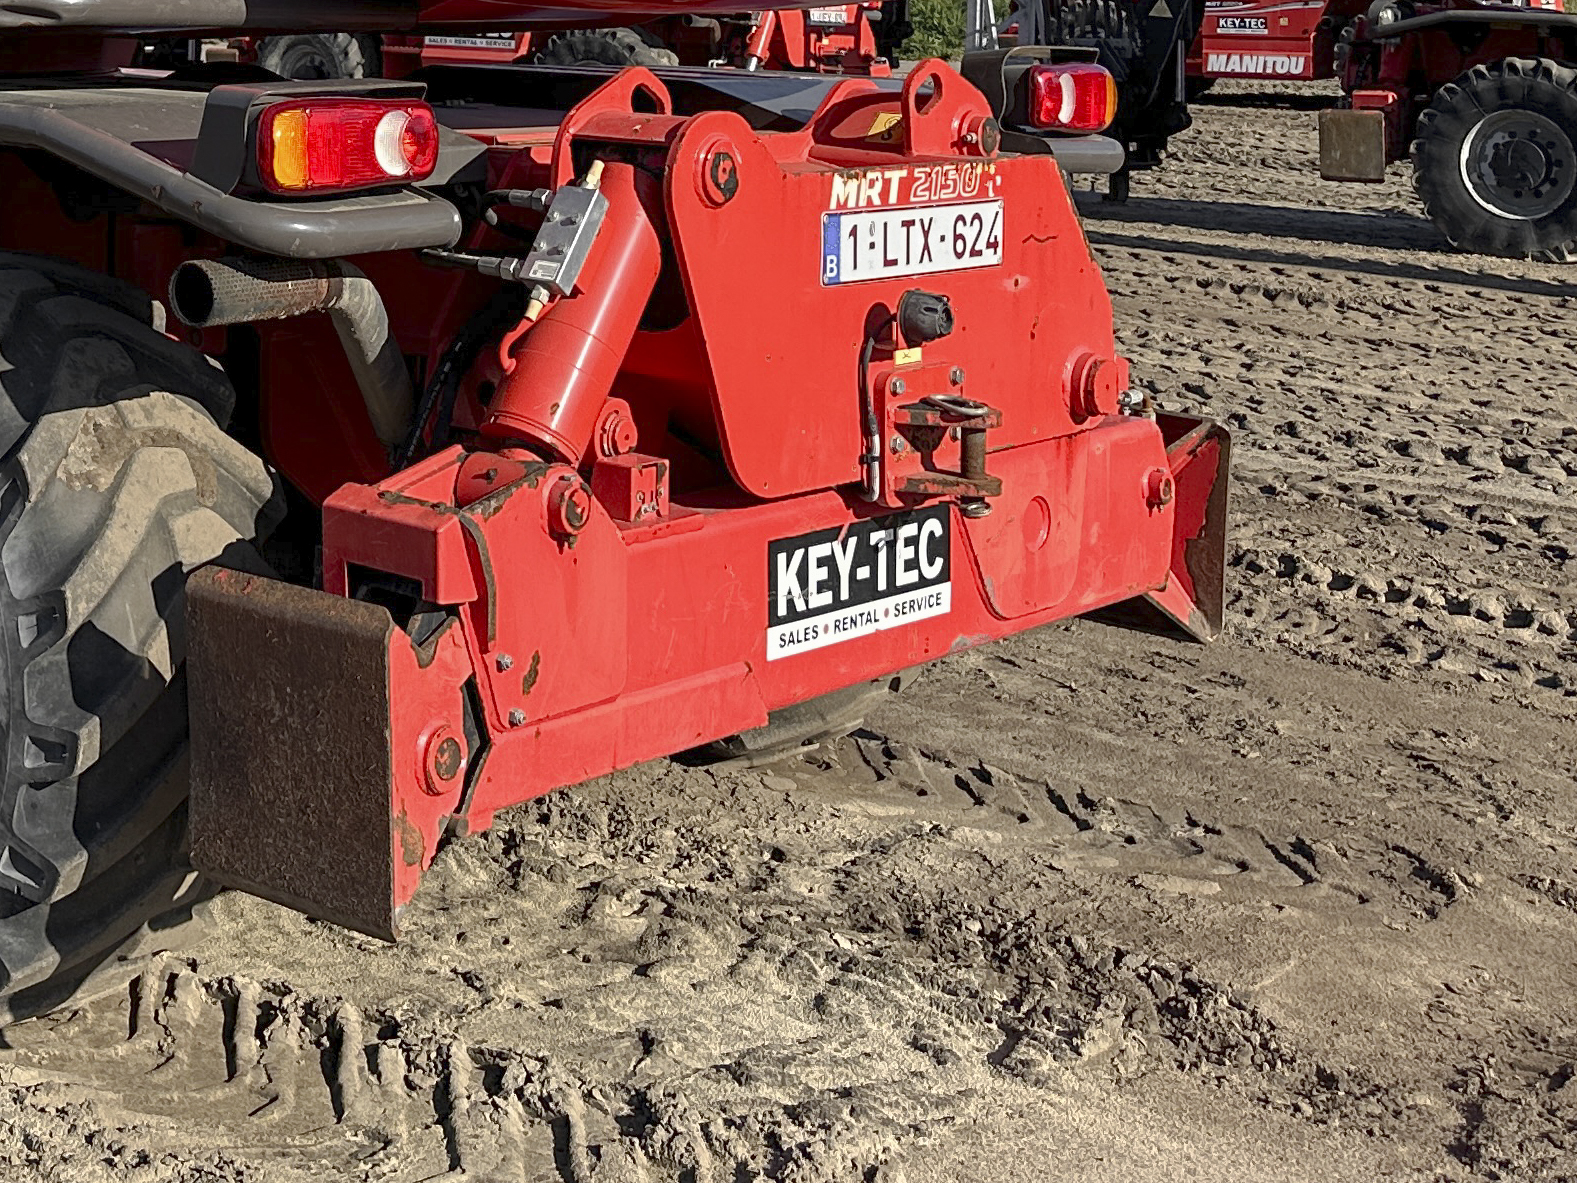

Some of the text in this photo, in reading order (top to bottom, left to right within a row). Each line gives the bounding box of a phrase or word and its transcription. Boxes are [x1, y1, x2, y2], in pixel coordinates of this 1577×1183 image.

[1219, 18, 1266, 29] KEY-TEC
[1207, 54, 1305, 75] MANITOU
[829, 169, 907, 210] MRT
[826, 254, 838, 278] B
[777, 517, 944, 617] KEY-TEC
[779, 592, 942, 649] SALES RENTAL SERVICE
